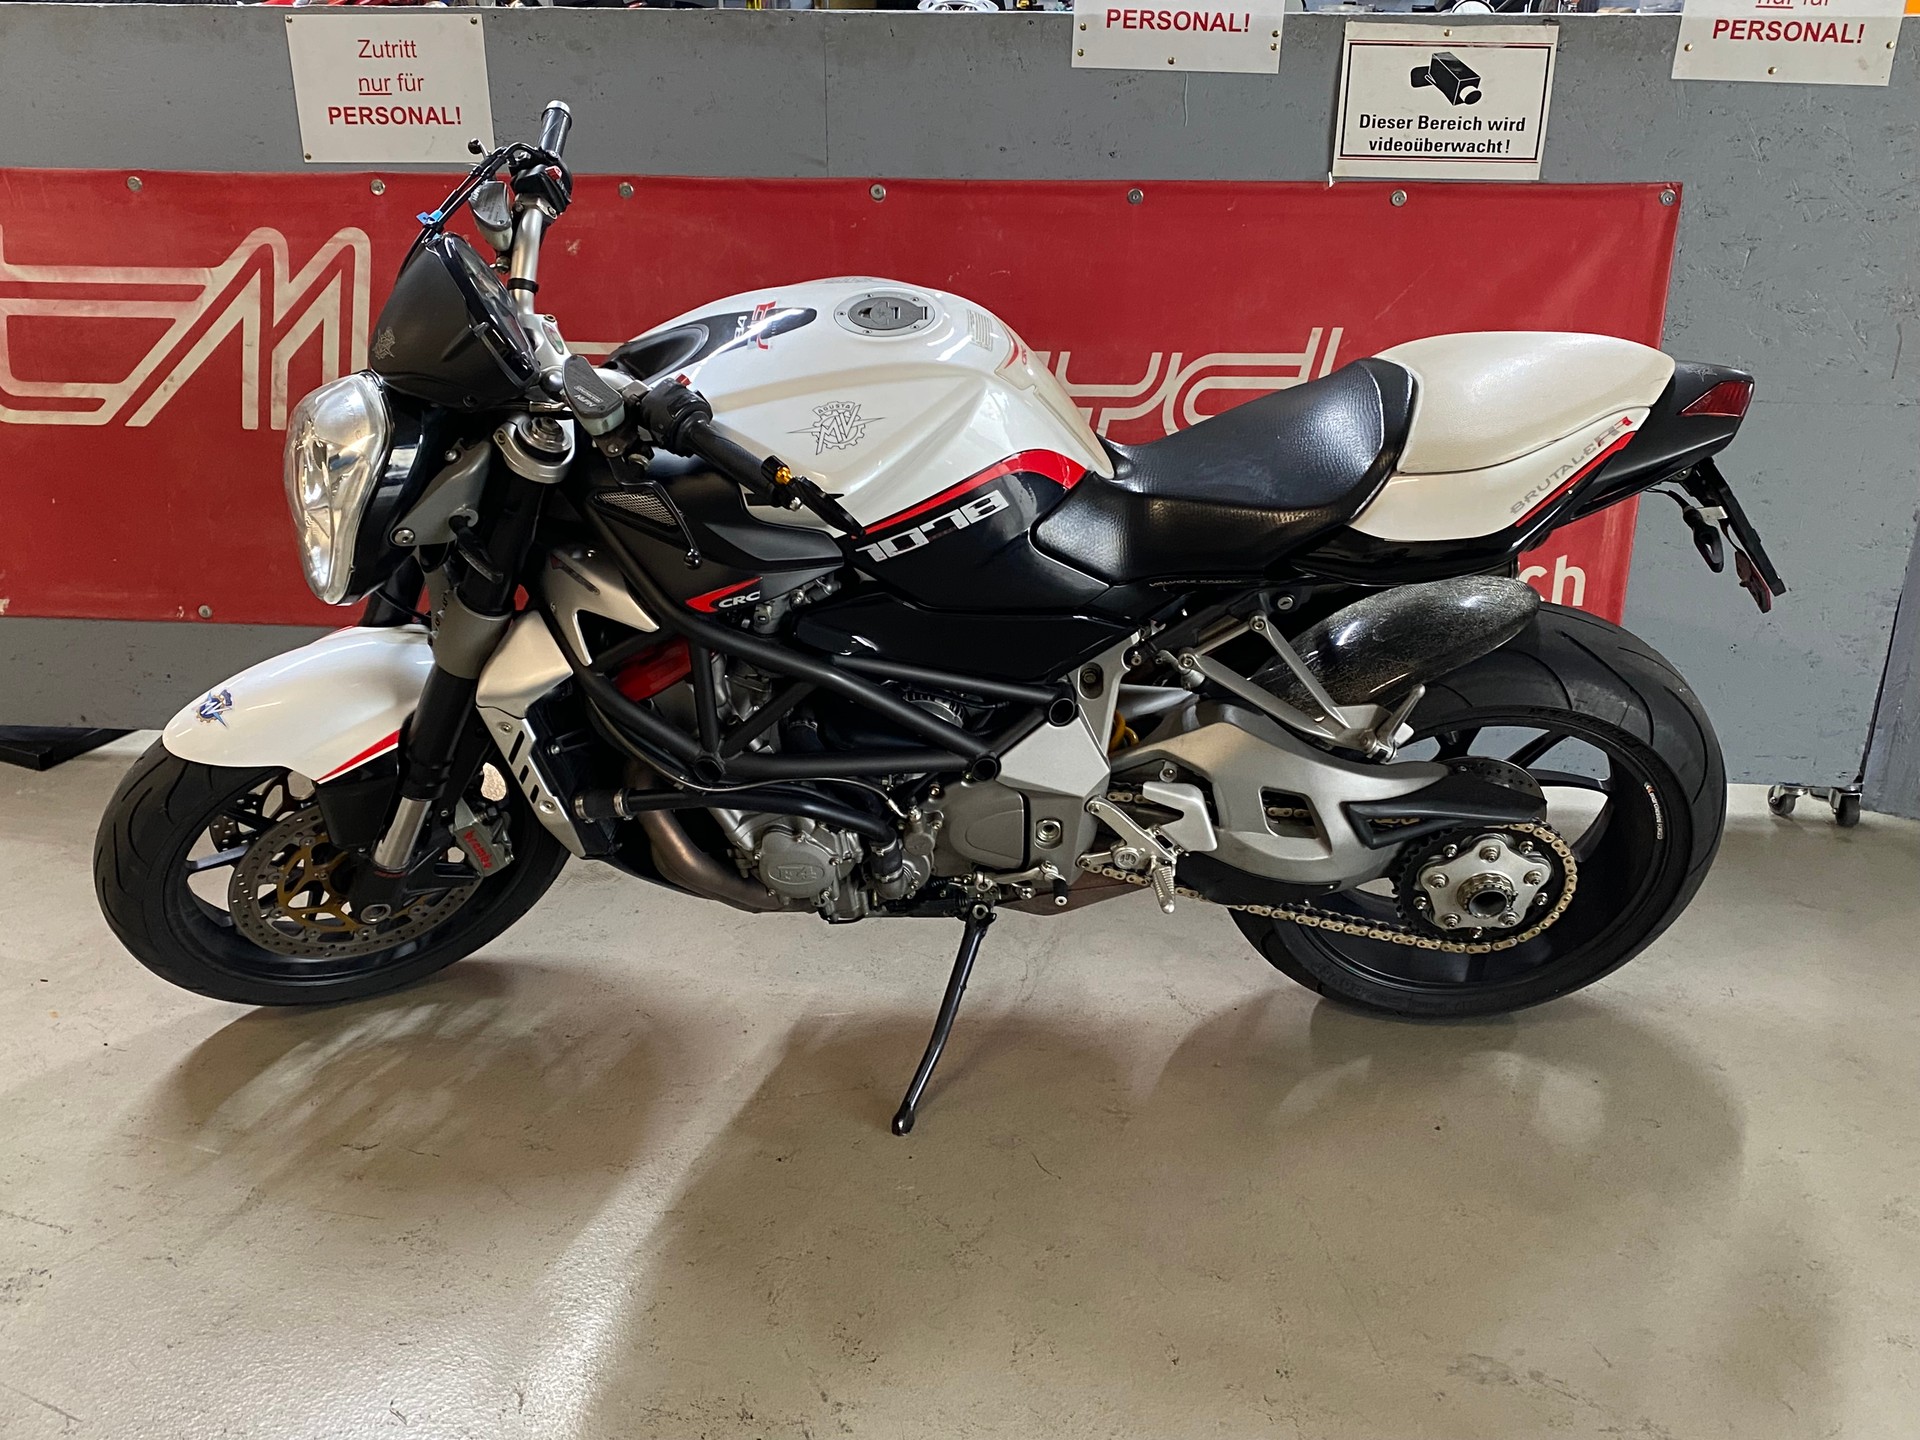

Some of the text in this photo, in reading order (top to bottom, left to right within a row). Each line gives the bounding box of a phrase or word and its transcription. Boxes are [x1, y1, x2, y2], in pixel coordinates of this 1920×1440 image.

[1106, 8, 1250, 33] PERSONAL!
[1712, 19, 1865, 44] PERSONAL!
[357, 39, 418, 58] Zutritt
[358, 73, 424, 95] nur für
[328, 106, 462, 125] PERSONAL!
[1359, 114, 1526, 132] Dieser Bereich wird
[817, 403, 851, 414] AGUSTA
[1510, 443, 1597, 515] BRUTALE
[855, 489, 1009, 562] 1078
[719, 590, 761, 608] CRC
